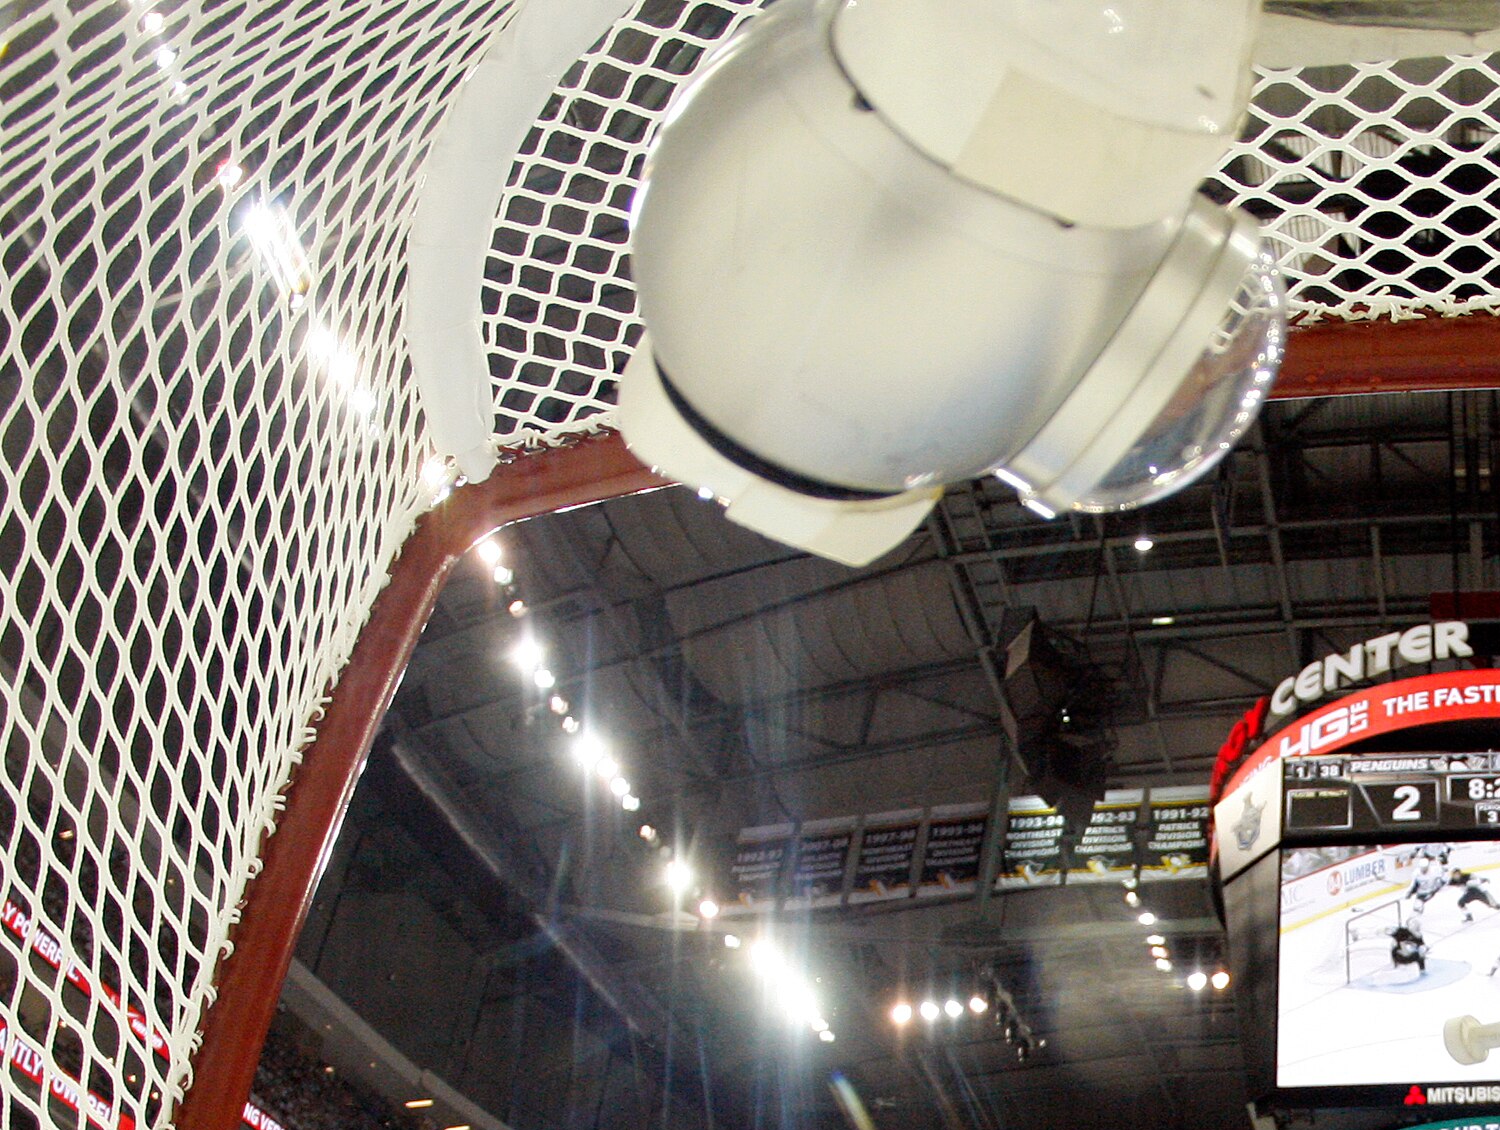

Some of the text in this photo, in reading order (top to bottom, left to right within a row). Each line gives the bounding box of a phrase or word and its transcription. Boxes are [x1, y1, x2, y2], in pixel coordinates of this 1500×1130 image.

[1270, 620, 1474, 715] CENTER
[1382, 693, 1429, 717] THE
[1320, 764, 1340, 778] 38
[1350, 758, 1429, 773] PENGUINS
[1392, 785, 1421, 821] 2
[1487, 810, 1499, 823] 3
